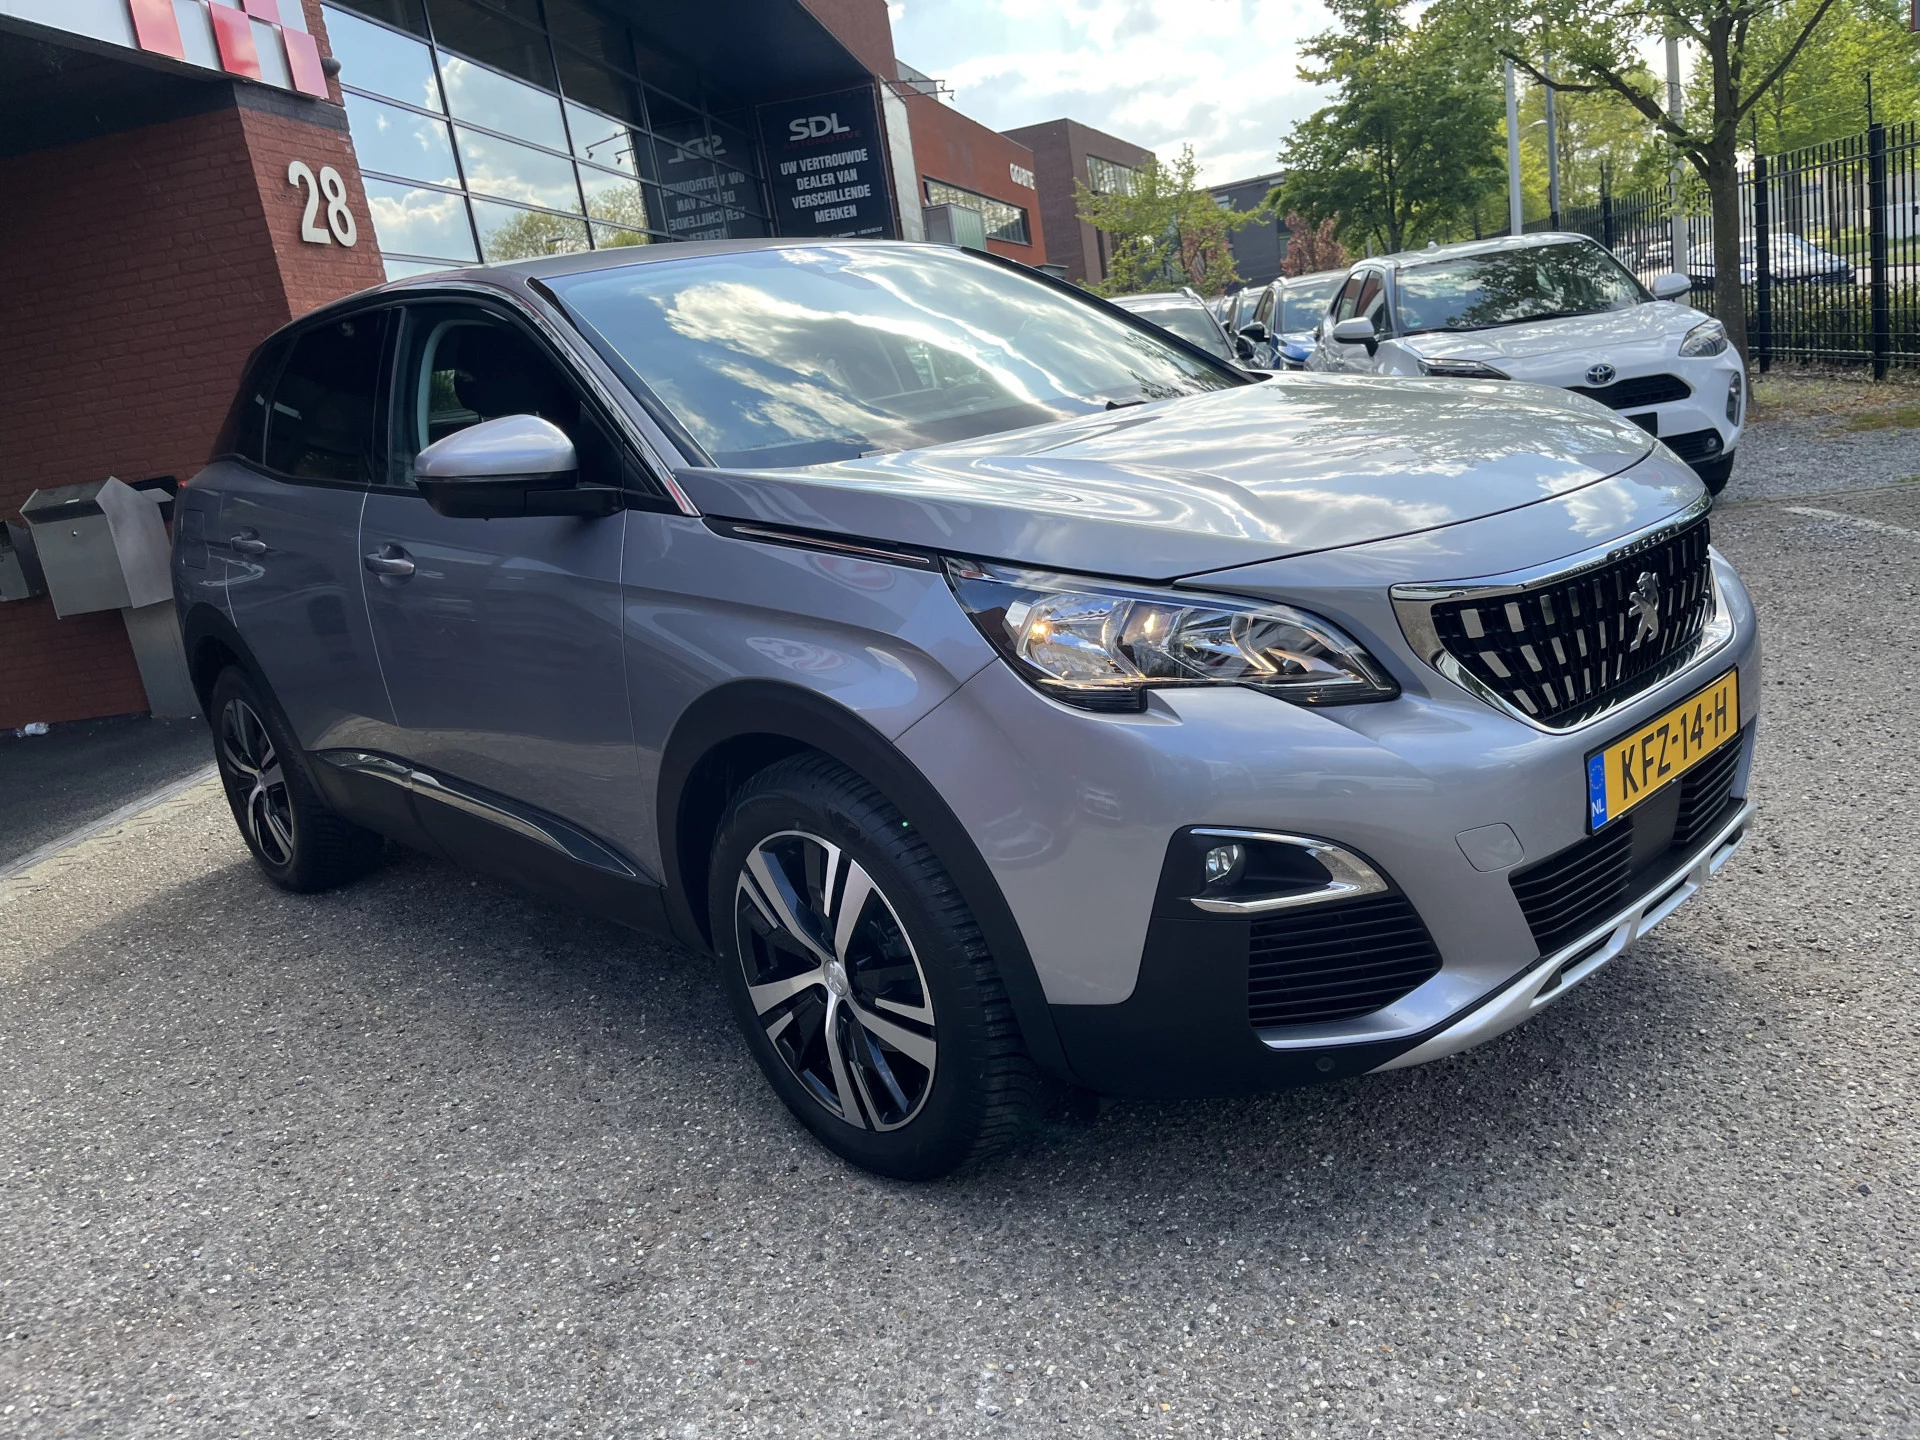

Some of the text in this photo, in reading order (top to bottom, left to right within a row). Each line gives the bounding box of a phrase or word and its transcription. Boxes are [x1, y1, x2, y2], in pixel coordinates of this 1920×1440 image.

[789, 112, 850, 142] SDL
[780, 148, 869, 176] UW VERTROUWDE
[796, 168, 858, 191] DEALER VAN
[288, 160, 358, 248] 28
[792, 184, 872, 209] VERSCHILLENDE
[814, 204, 858, 224] MERKEN
[1614, 528, 1671, 561] PEUGEOT
[1621, 686, 1727, 801] KFZ-14-H
[1591, 798, 1605, 817] NL
